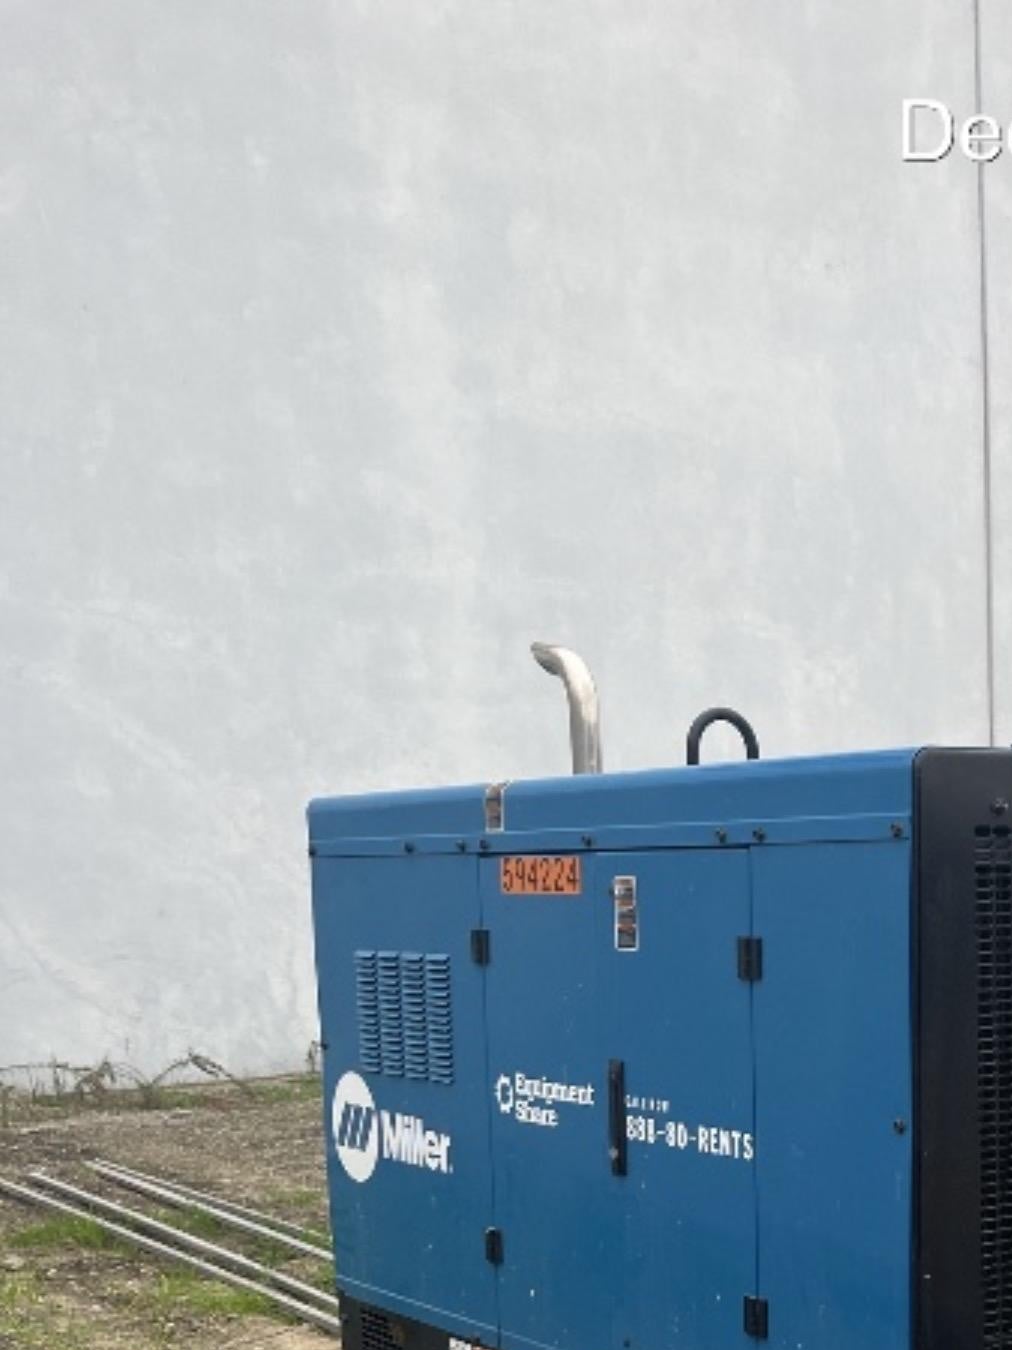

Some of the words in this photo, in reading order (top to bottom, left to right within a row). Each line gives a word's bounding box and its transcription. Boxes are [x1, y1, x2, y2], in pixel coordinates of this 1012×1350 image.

[502, 857, 579, 892] 594224
[515, 1072, 595, 1107] Equipment
[515, 1099, 558, 1128] Share
